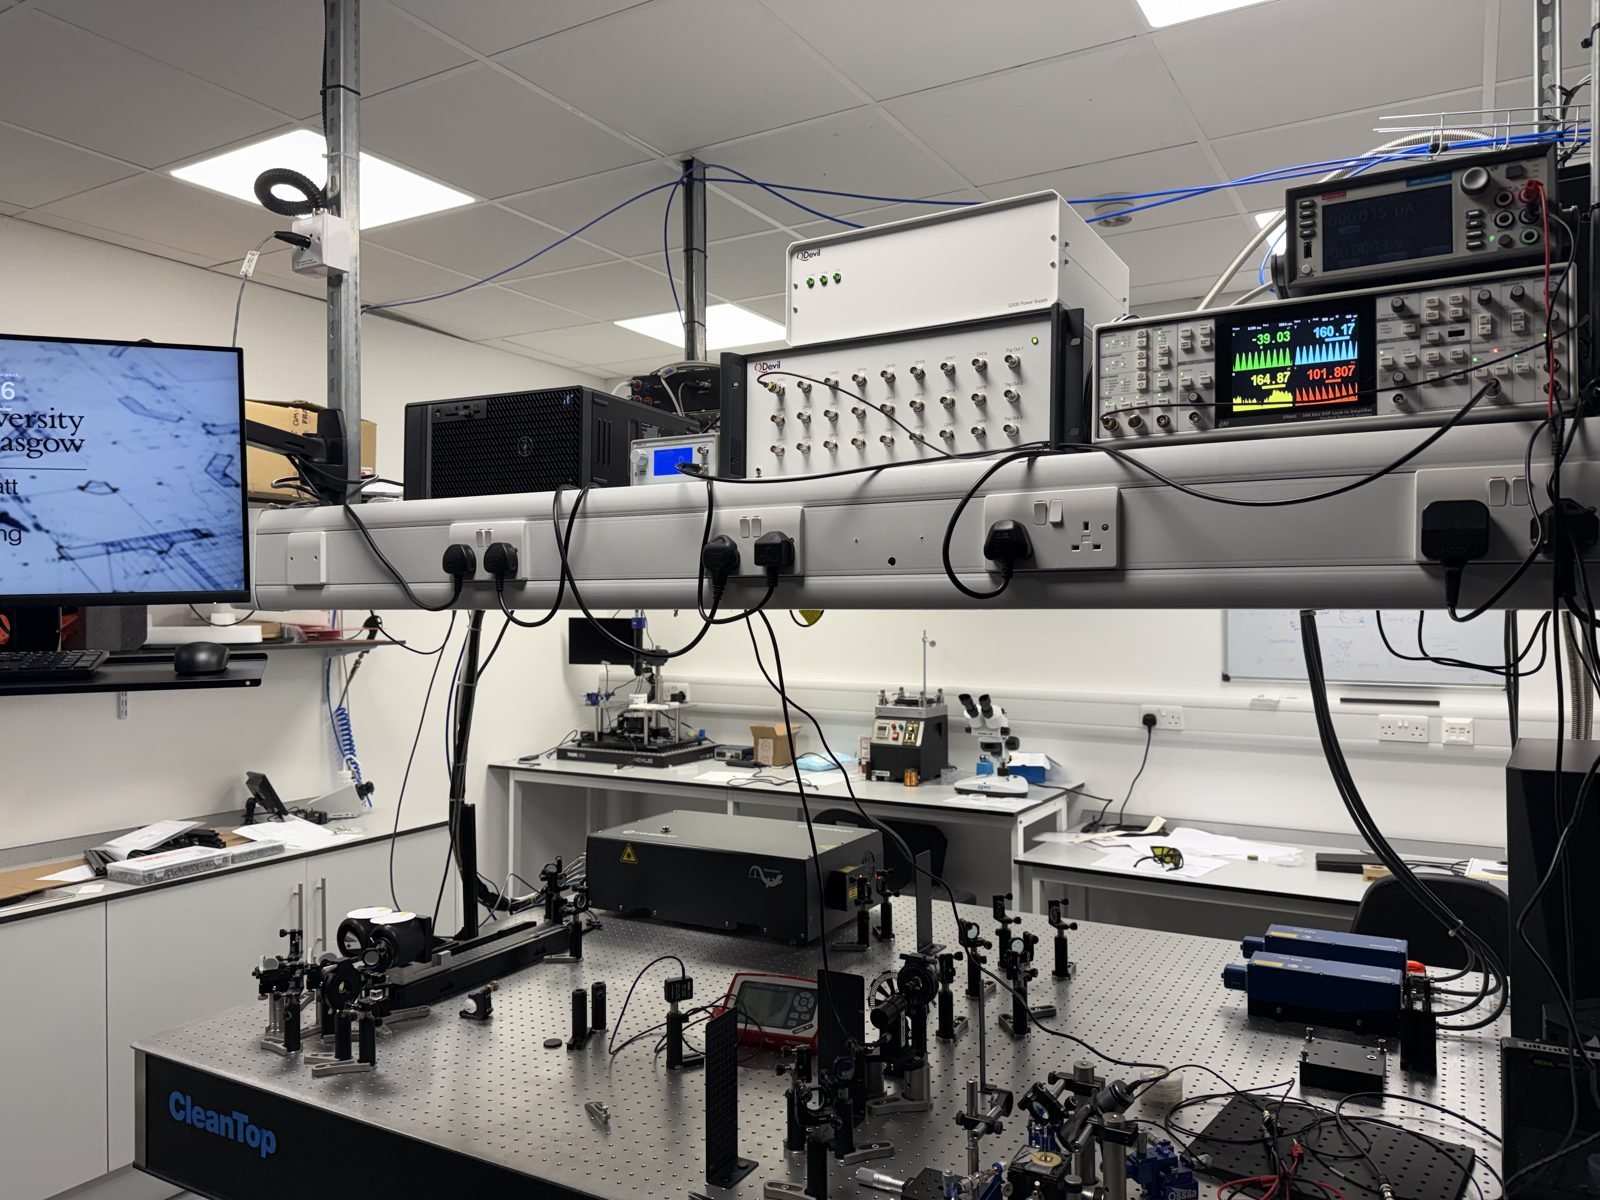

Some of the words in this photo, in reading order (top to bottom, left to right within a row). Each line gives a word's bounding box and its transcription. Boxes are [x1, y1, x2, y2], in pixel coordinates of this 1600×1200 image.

[796, 249, 821, 261] QDevil
[1251, 331, 1291, 345] -39.03
[1313, 323, 1356, 338] 160.17
[754, 361, 781, 373] QDevil
[1307, 365, 1356, 381] 101.807
[1250, 371, 1291, 386] 164.87
[0, 436, 85, 459] asgow
[168, 1090, 277, 1158] CleanTop
